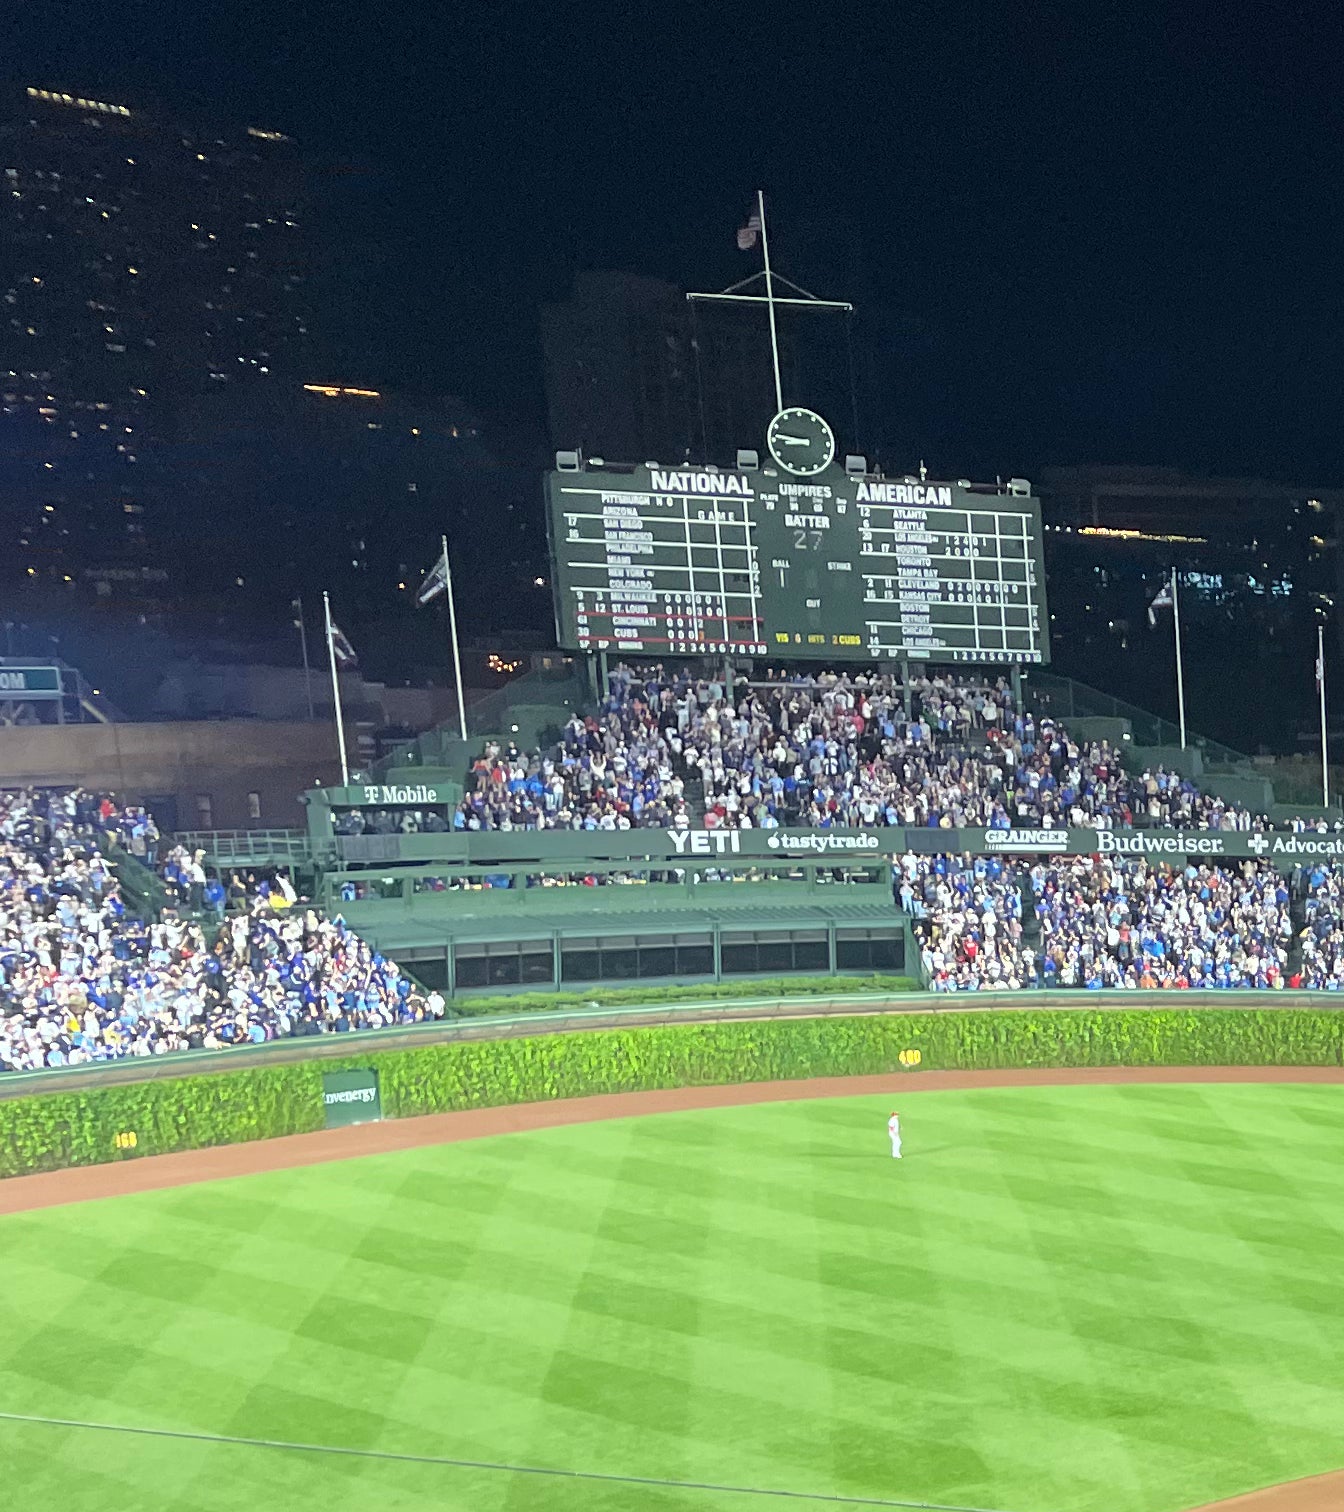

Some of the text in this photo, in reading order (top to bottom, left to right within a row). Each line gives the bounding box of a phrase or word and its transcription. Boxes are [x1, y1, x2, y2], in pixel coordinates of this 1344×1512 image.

[651, 471, 754, 495] NATIONAL
[779, 483, 832, 498] UMPIRES
[856, 483, 952, 506] AMERICAN
[785, 514, 830, 528] BATTER
[893, 509, 928, 520] ATLANTA
[894, 521, 925, 531] SEATTLE
[794, 530, 822, 550] 27
[772, 560, 790, 568] BALL
[806, 598, 820, 608] OUT
[614, 628, 638, 638] CUBS
[839, 635, 861, 646] CUBS
[382, 785, 436, 803] Mobile
[668, 829, 740, 854] YETI
[781, 833, 878, 852] tastytrade
[984, 830, 1069, 844] GRAINGER
[1097, 832, 1222, 854] Budweiser
